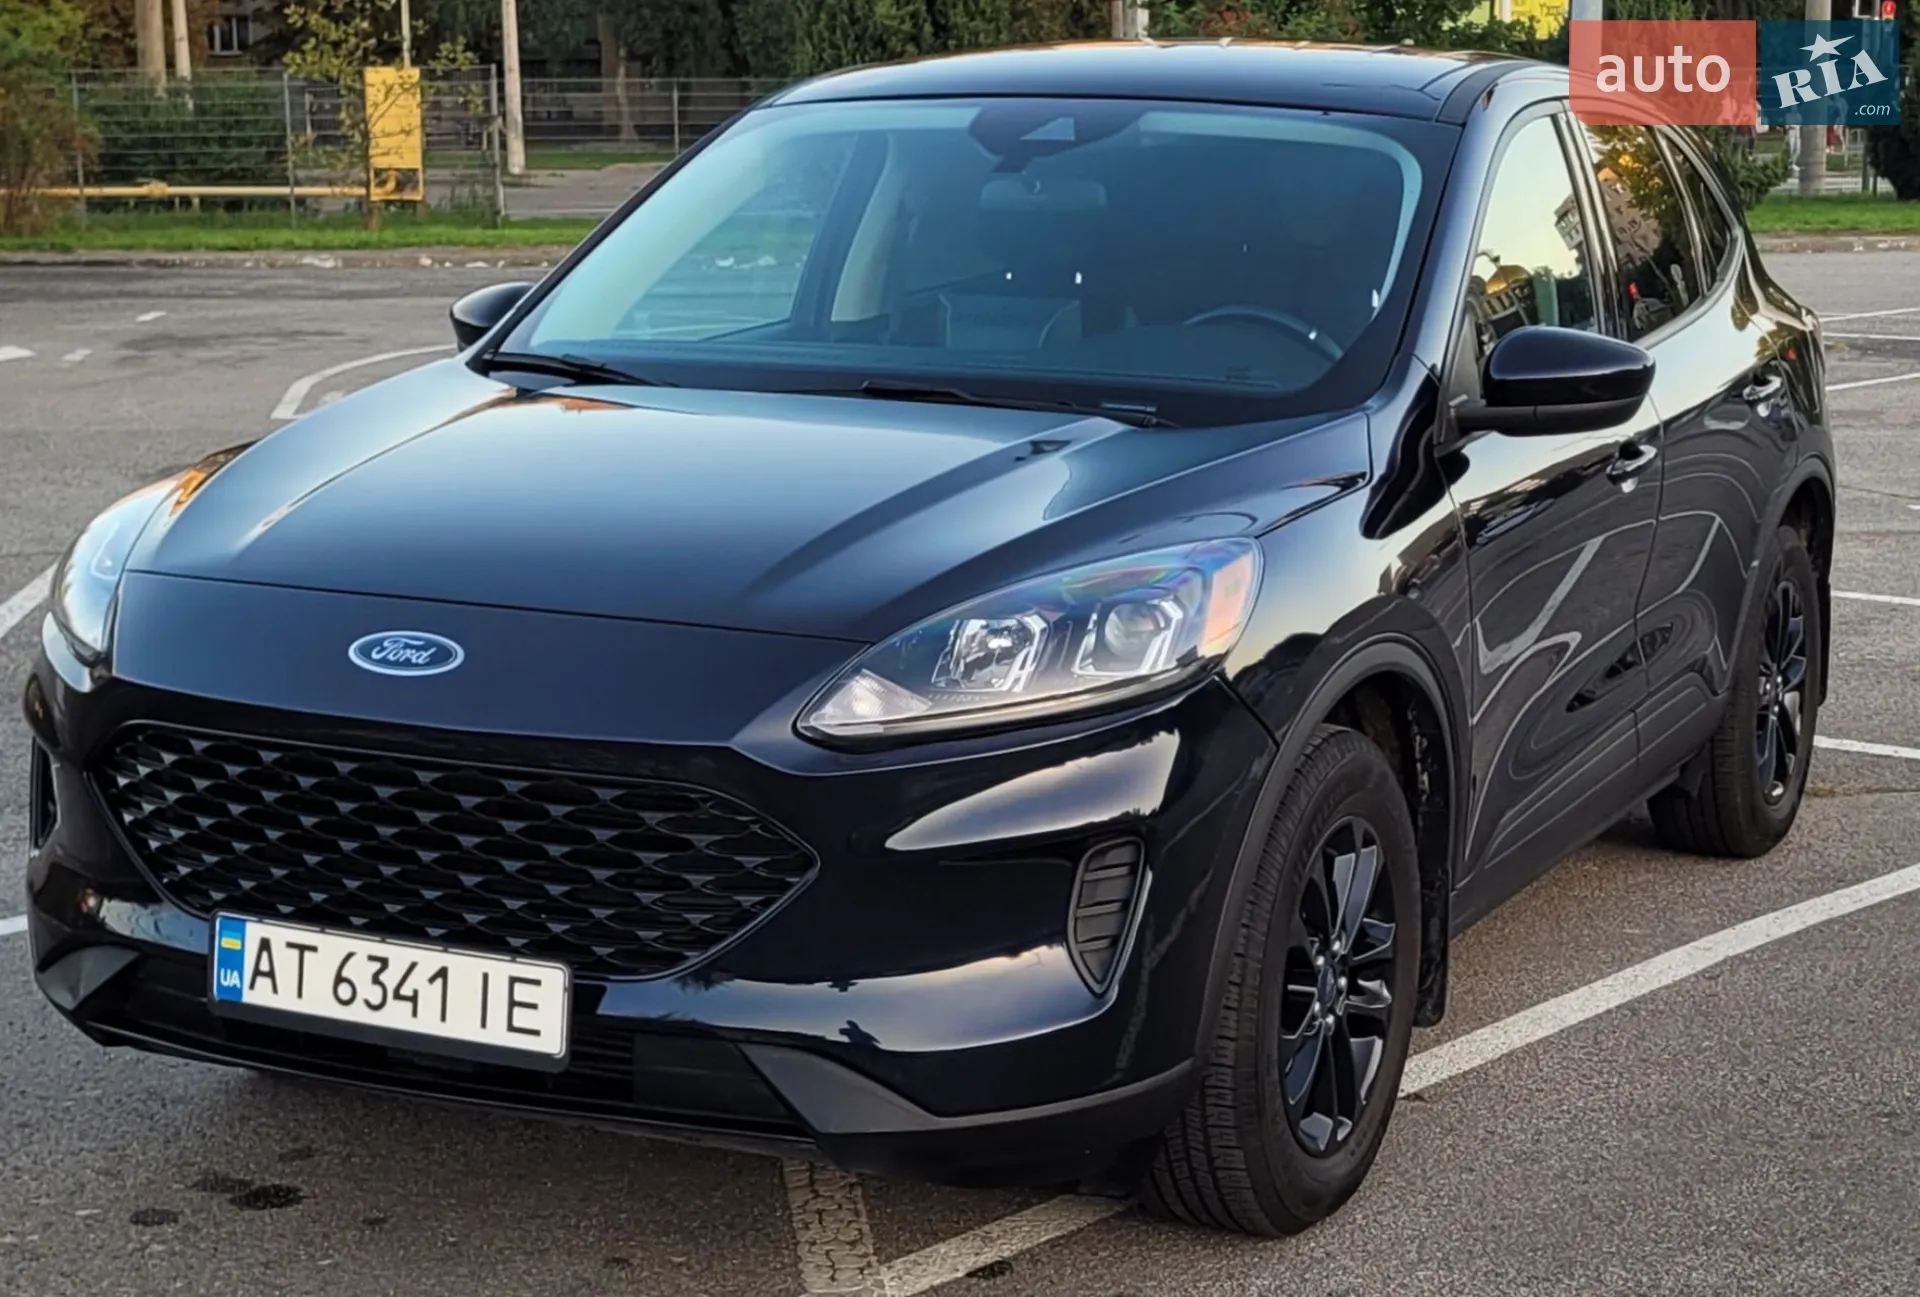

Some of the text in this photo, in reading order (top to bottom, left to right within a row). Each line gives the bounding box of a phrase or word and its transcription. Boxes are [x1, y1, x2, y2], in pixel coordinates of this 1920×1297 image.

[371, 637, 437, 664] Ford
[220, 967, 241, 988] UA
[248, 937, 543, 1036] AT 6341 IE
